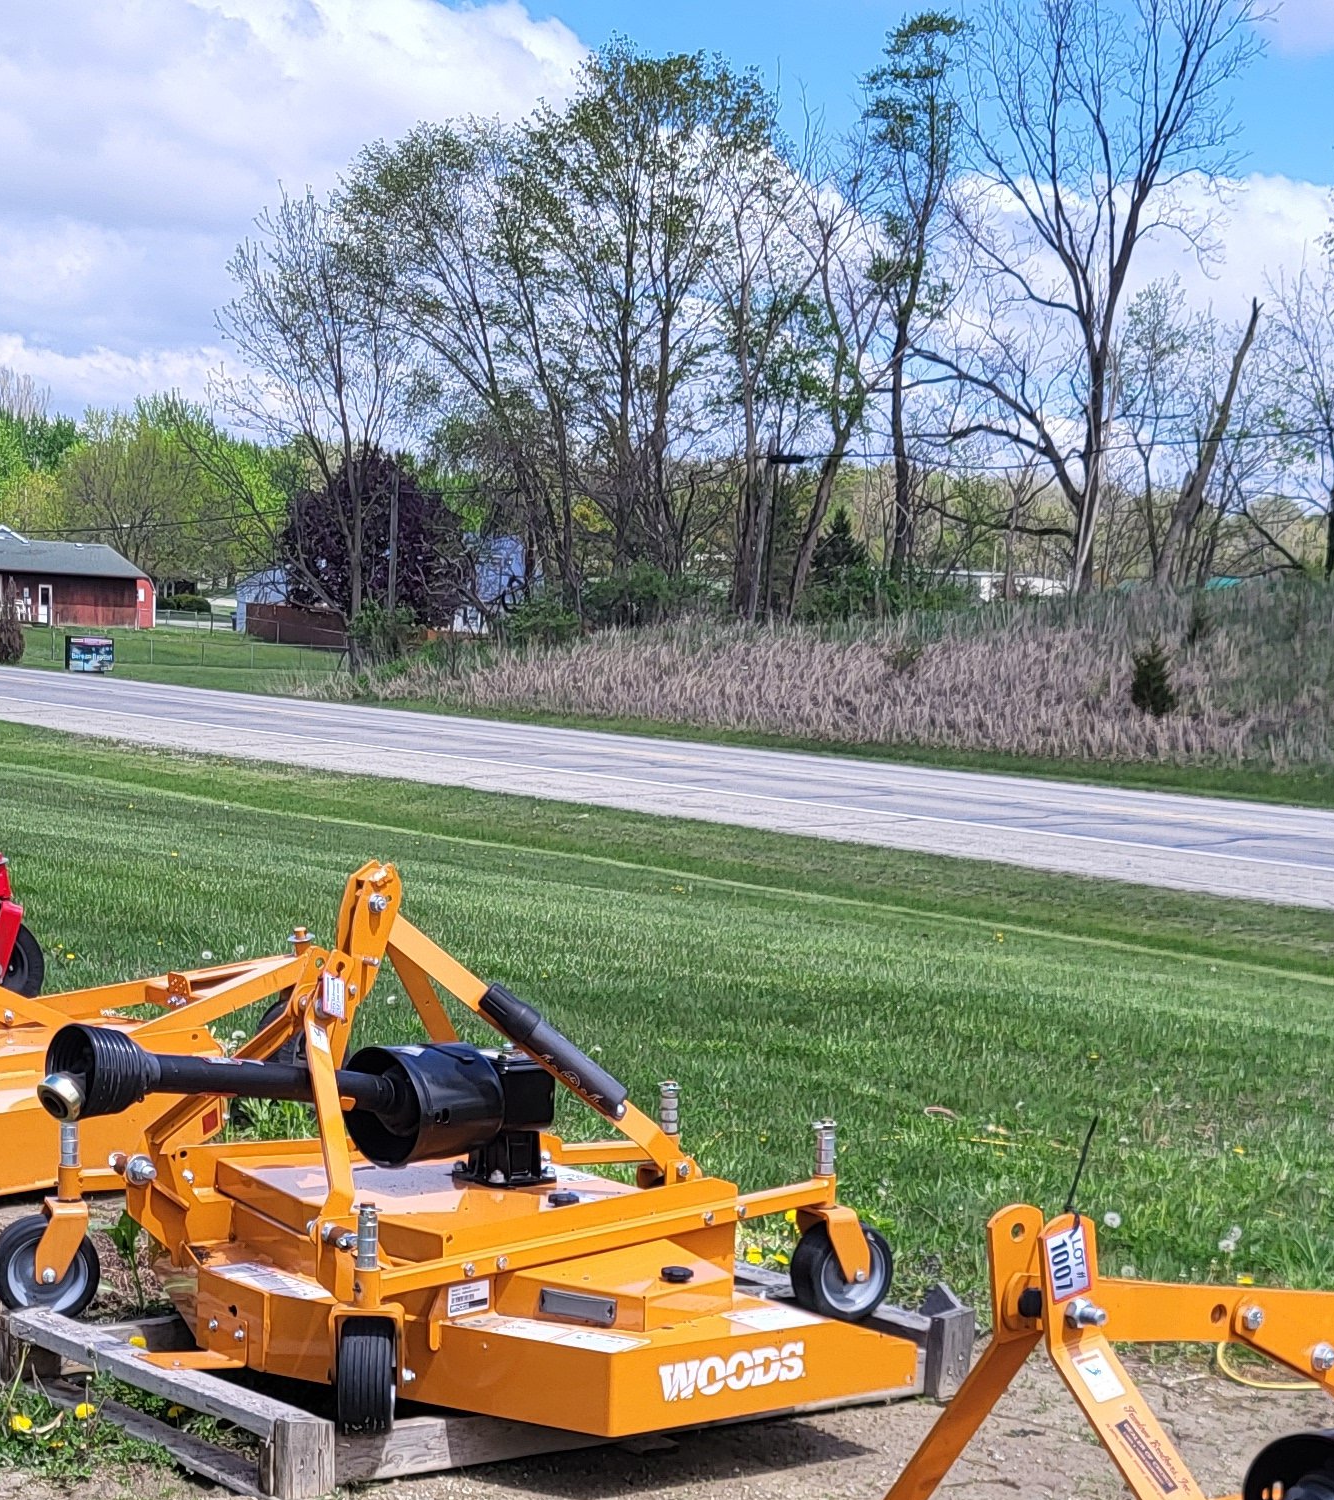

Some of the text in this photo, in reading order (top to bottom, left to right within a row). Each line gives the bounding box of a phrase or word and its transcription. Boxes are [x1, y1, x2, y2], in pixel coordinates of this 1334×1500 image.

[1050, 1239, 1074, 1291] 1007
[1071, 1238, 1086, 1279] LOT #
[659, 1341, 804, 1402] WOODS
